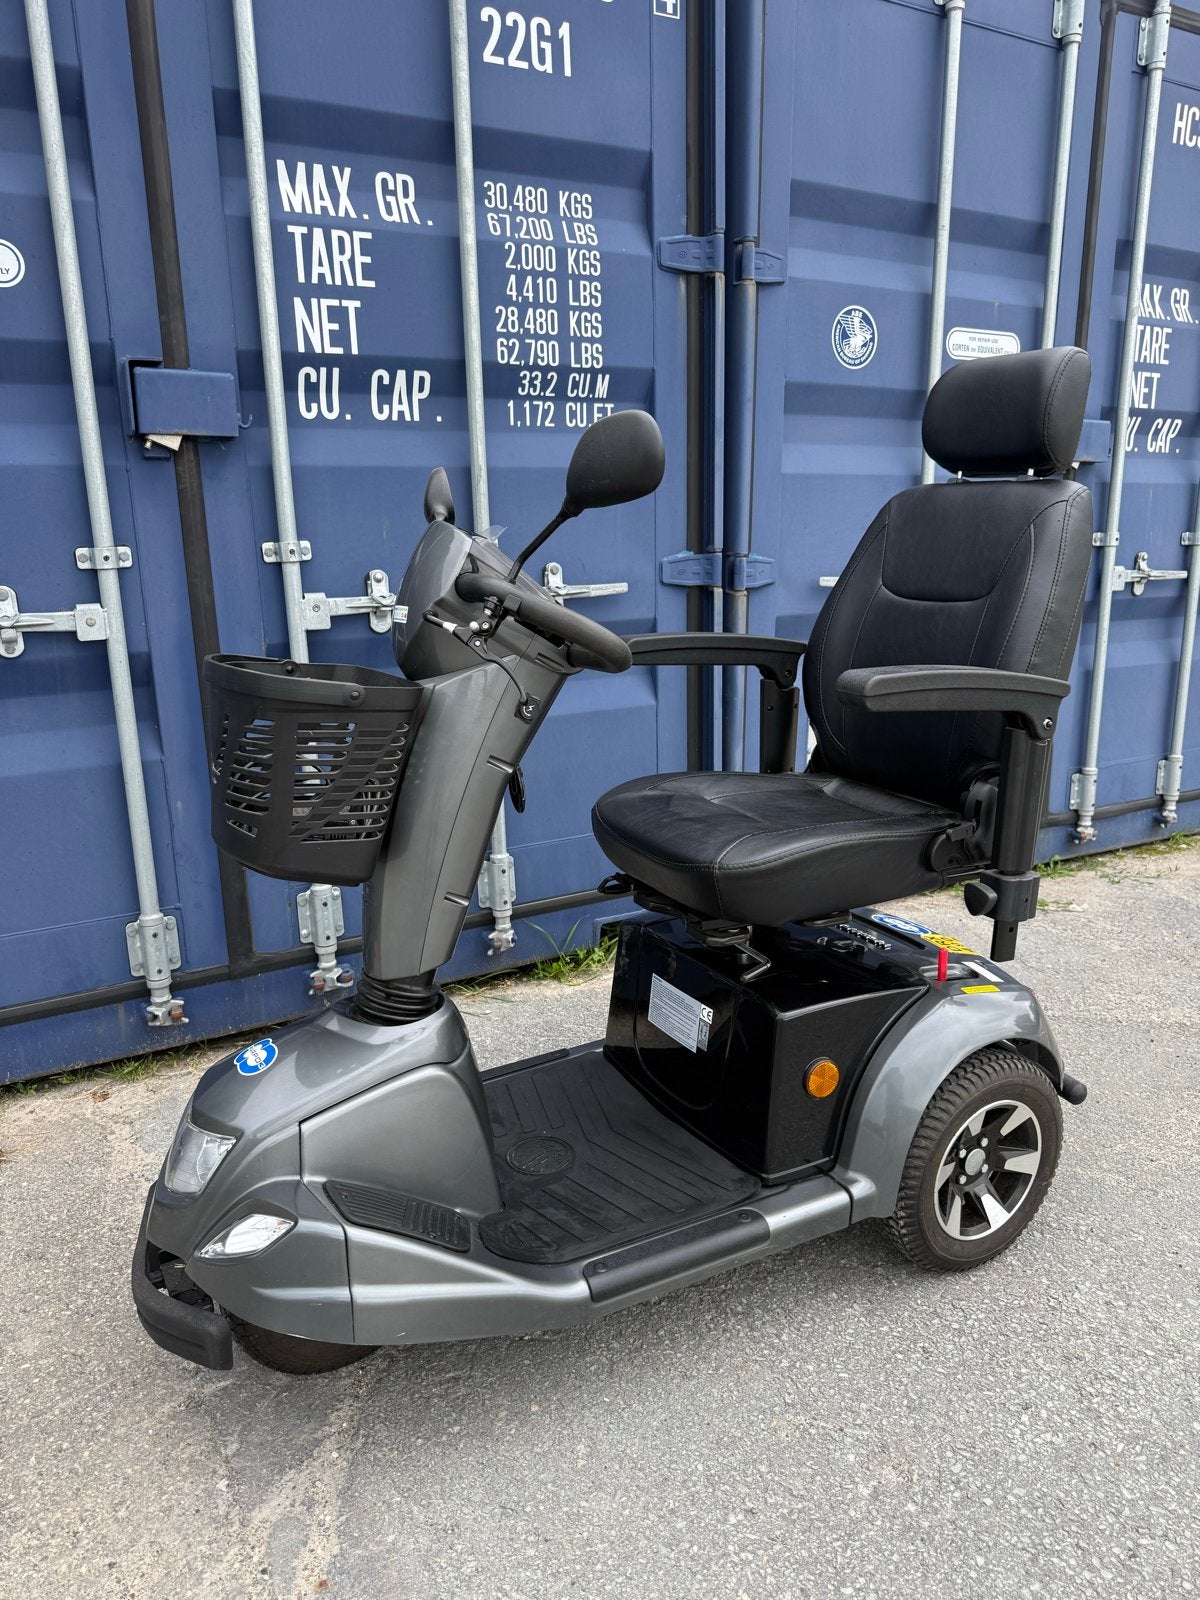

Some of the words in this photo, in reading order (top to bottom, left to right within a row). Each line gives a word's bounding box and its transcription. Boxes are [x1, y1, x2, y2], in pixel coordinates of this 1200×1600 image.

[481, 6, 572, 77] 22G1
[1173, 102, 1200, 149] HC
[276, 159, 369, 220] MAX.
[375, 171, 434, 226] GR.
[483, 181, 548, 215] 30,480
[558, 190, 593, 220] KGS
[486, 212, 554, 241] 67,200
[563, 220, 599, 246] LBS
[287, 225, 376, 288] TARE
[504, 241, 557, 272] 2,000
[567, 248, 601, 277] KGS
[506, 274, 558, 304] 4,410
[568, 280, 602, 308] LBS
[1171, 288, 1200, 325] GR.
[293, 296, 361, 355] NET
[495, 305, 559, 336] 28,480
[569, 311, 603, 339] KGS
[496, 338, 560, 367] 62,790
[570, 342, 603, 369] LBS
[1134, 325, 1173, 366] TARE
[297, 366, 352, 421] CU.
[370, 369, 442, 422] CAP.
[517, 371, 558, 397] 33.2
[567, 373, 610, 399] CU.M
[1129, 371, 1161, 410] NET
[507, 400, 555, 427] 1,172
[1125, 416, 1142, 453] U.
[1146, 417, 1183, 454] CAP.
